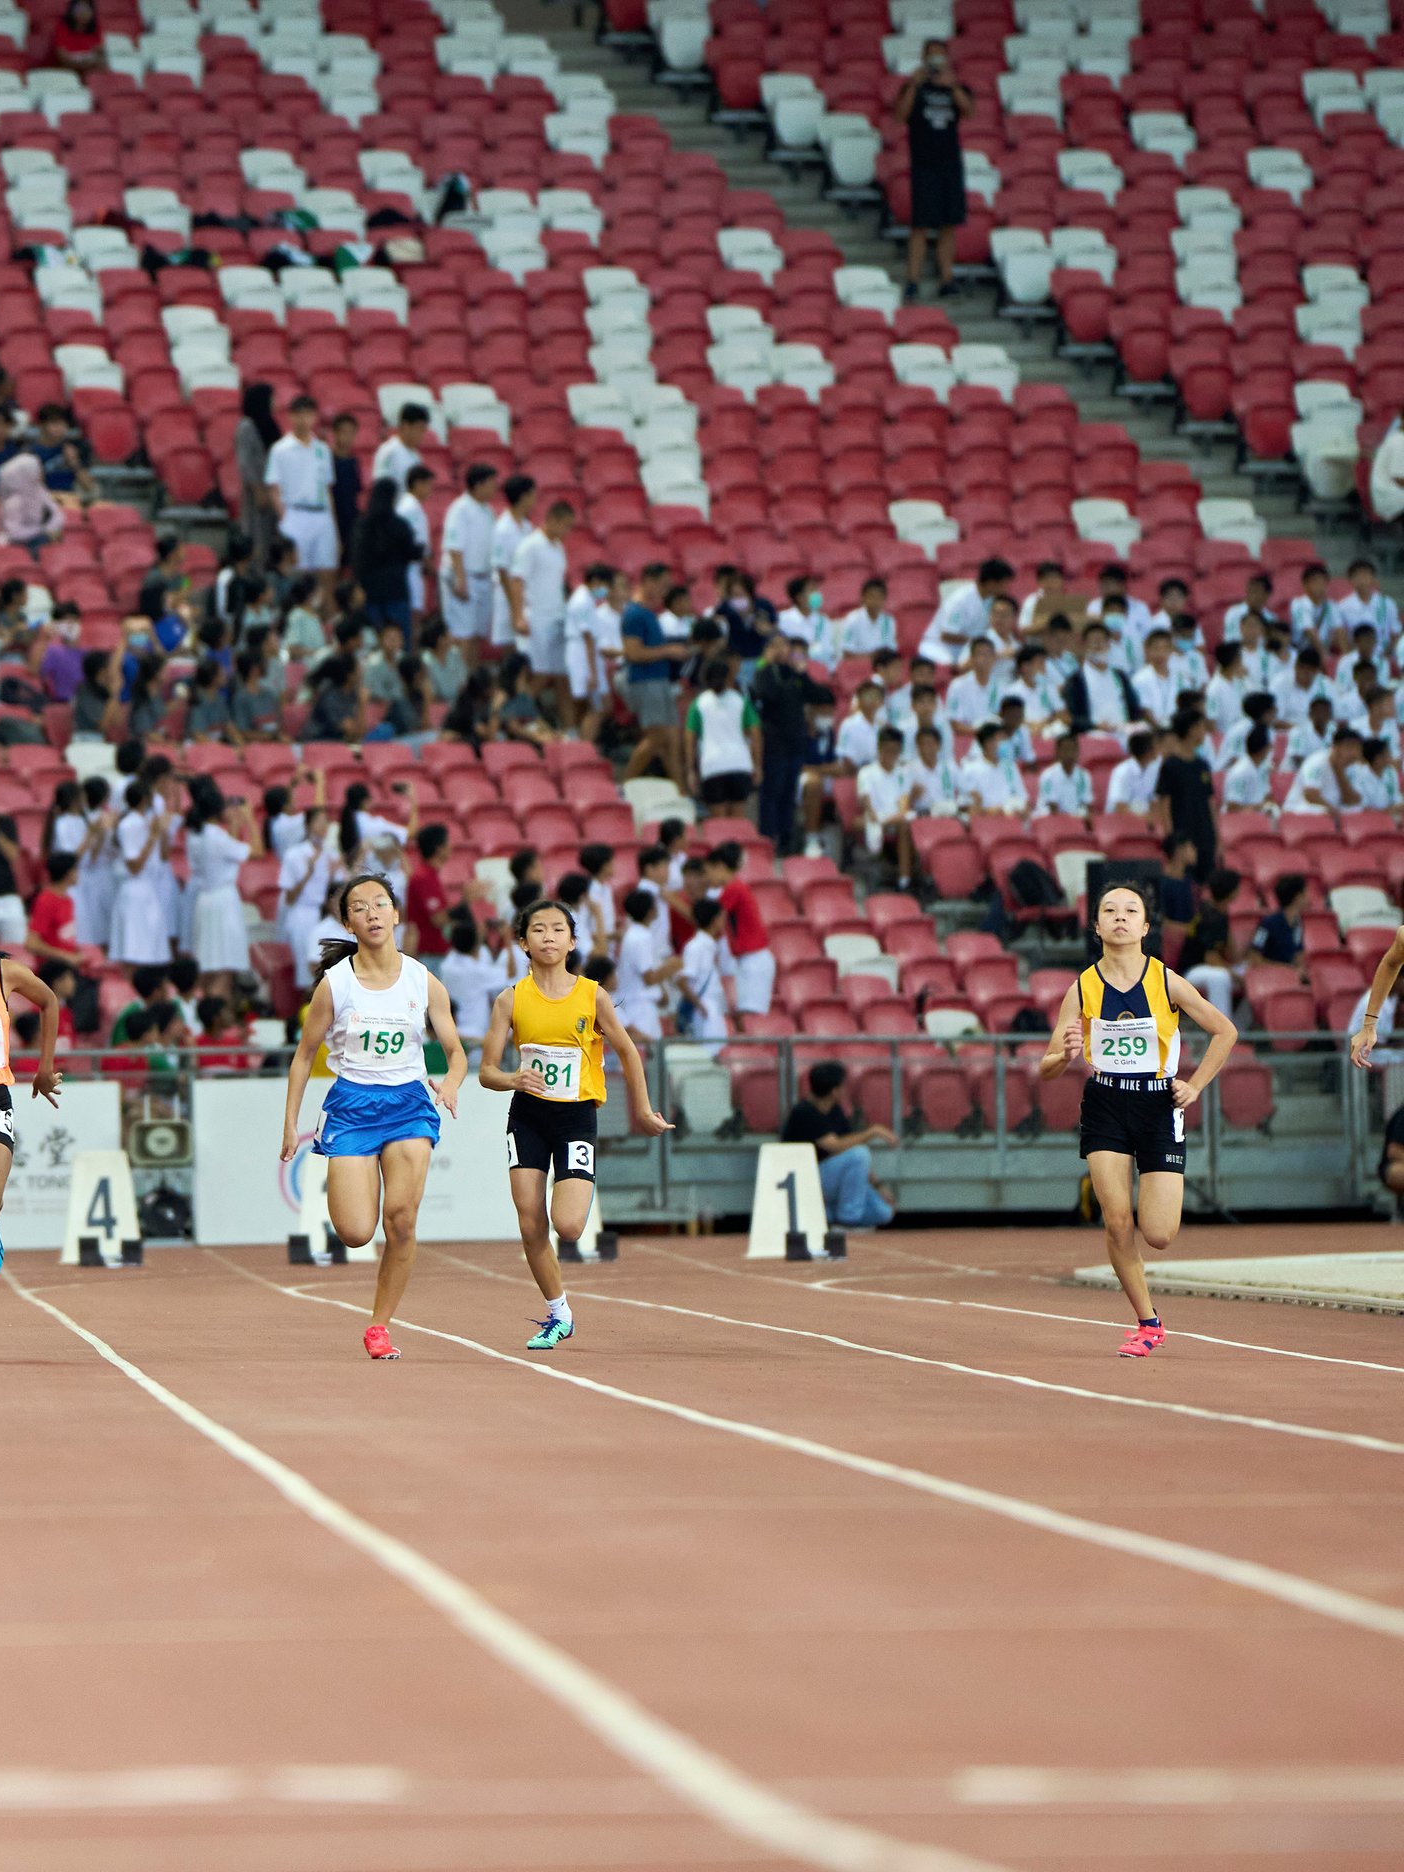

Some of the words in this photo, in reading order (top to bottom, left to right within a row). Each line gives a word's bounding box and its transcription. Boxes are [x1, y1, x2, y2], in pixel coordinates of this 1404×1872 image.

[359, 1030, 405, 1055] 159
[1101, 1036, 1148, 1056] 259
[1120, 1078, 1141, 1091] NIKE
[1147, 1079, 1168, 1091] NIKE
[576, 1144, 590, 1167] 3
[87, 1176, 117, 1239] 4
[776, 1171, 798, 1233] 1
